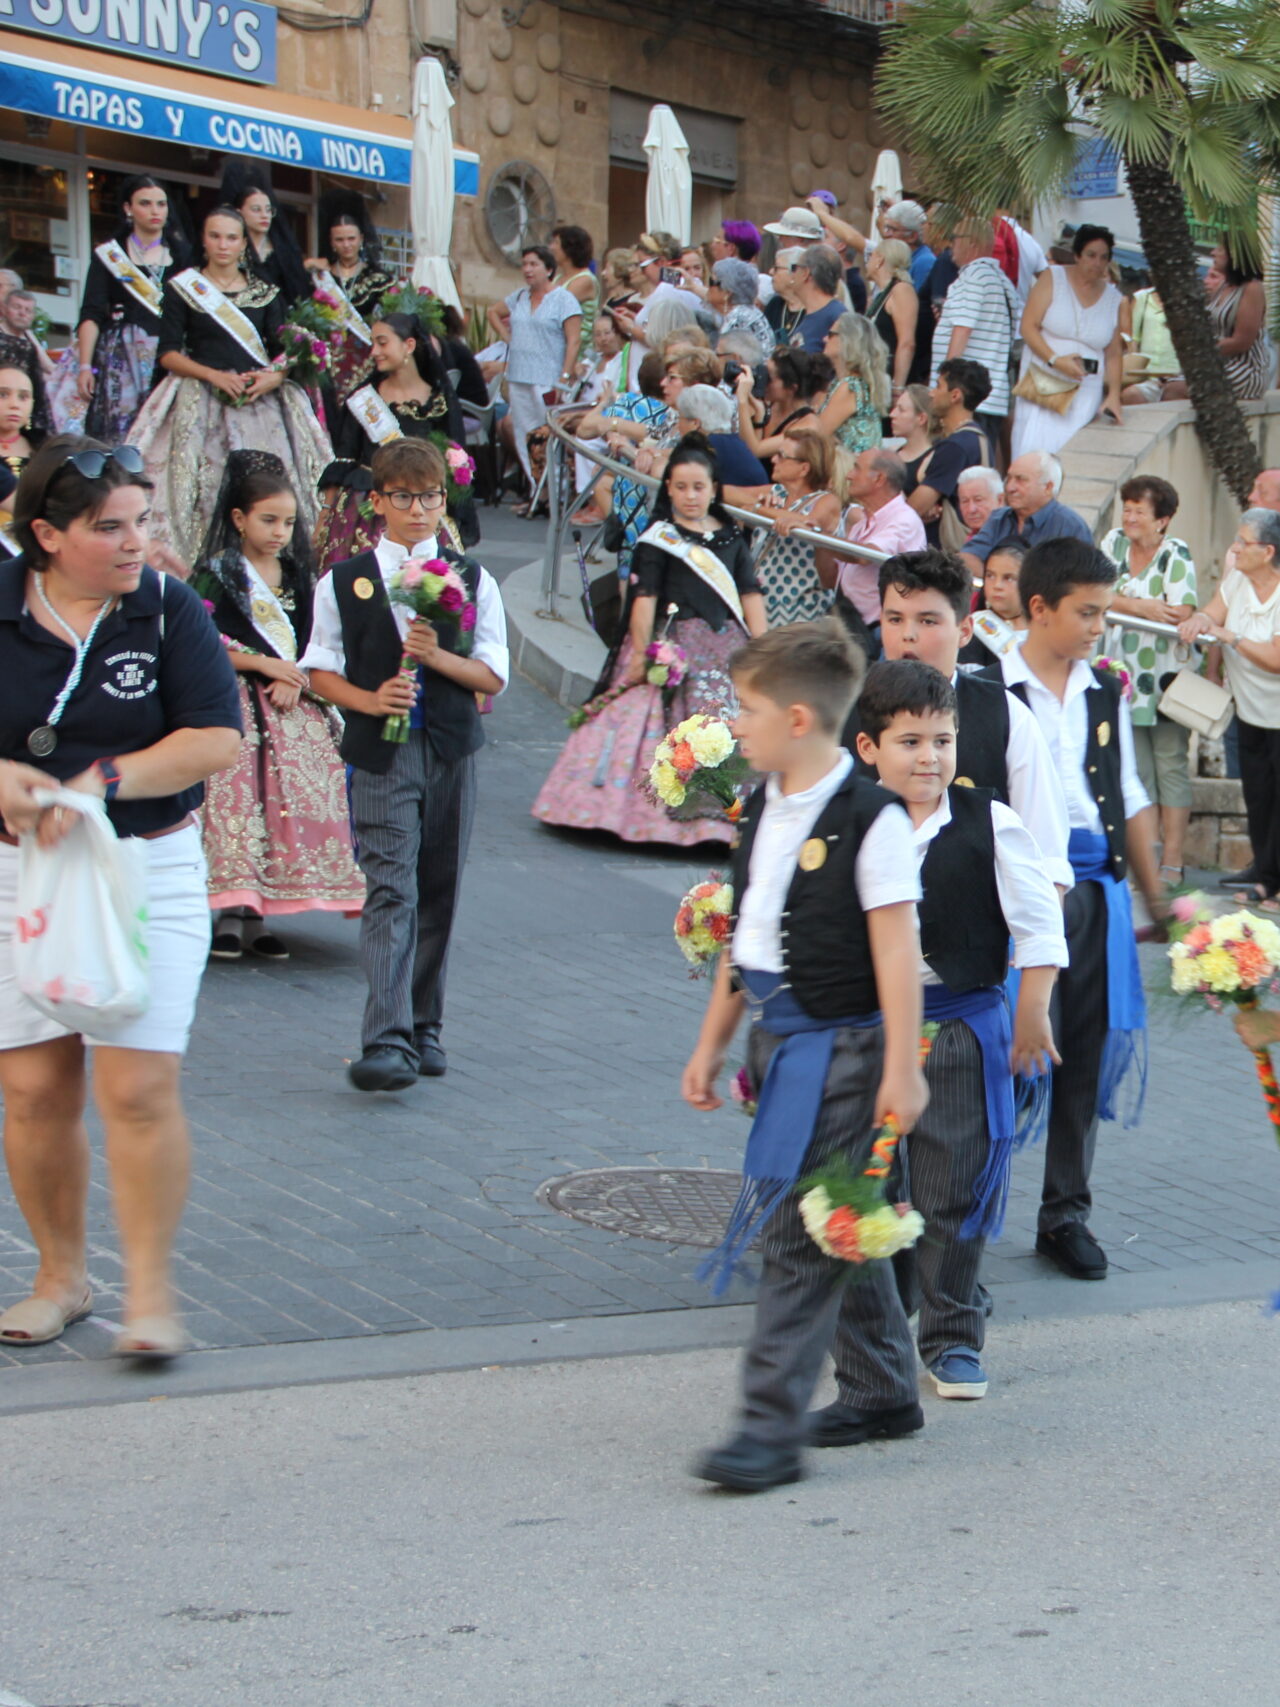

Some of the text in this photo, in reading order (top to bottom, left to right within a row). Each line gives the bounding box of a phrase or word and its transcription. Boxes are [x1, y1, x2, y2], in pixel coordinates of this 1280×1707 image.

[53, 81, 386, 177] TAPAS Y COCINA INDIA
